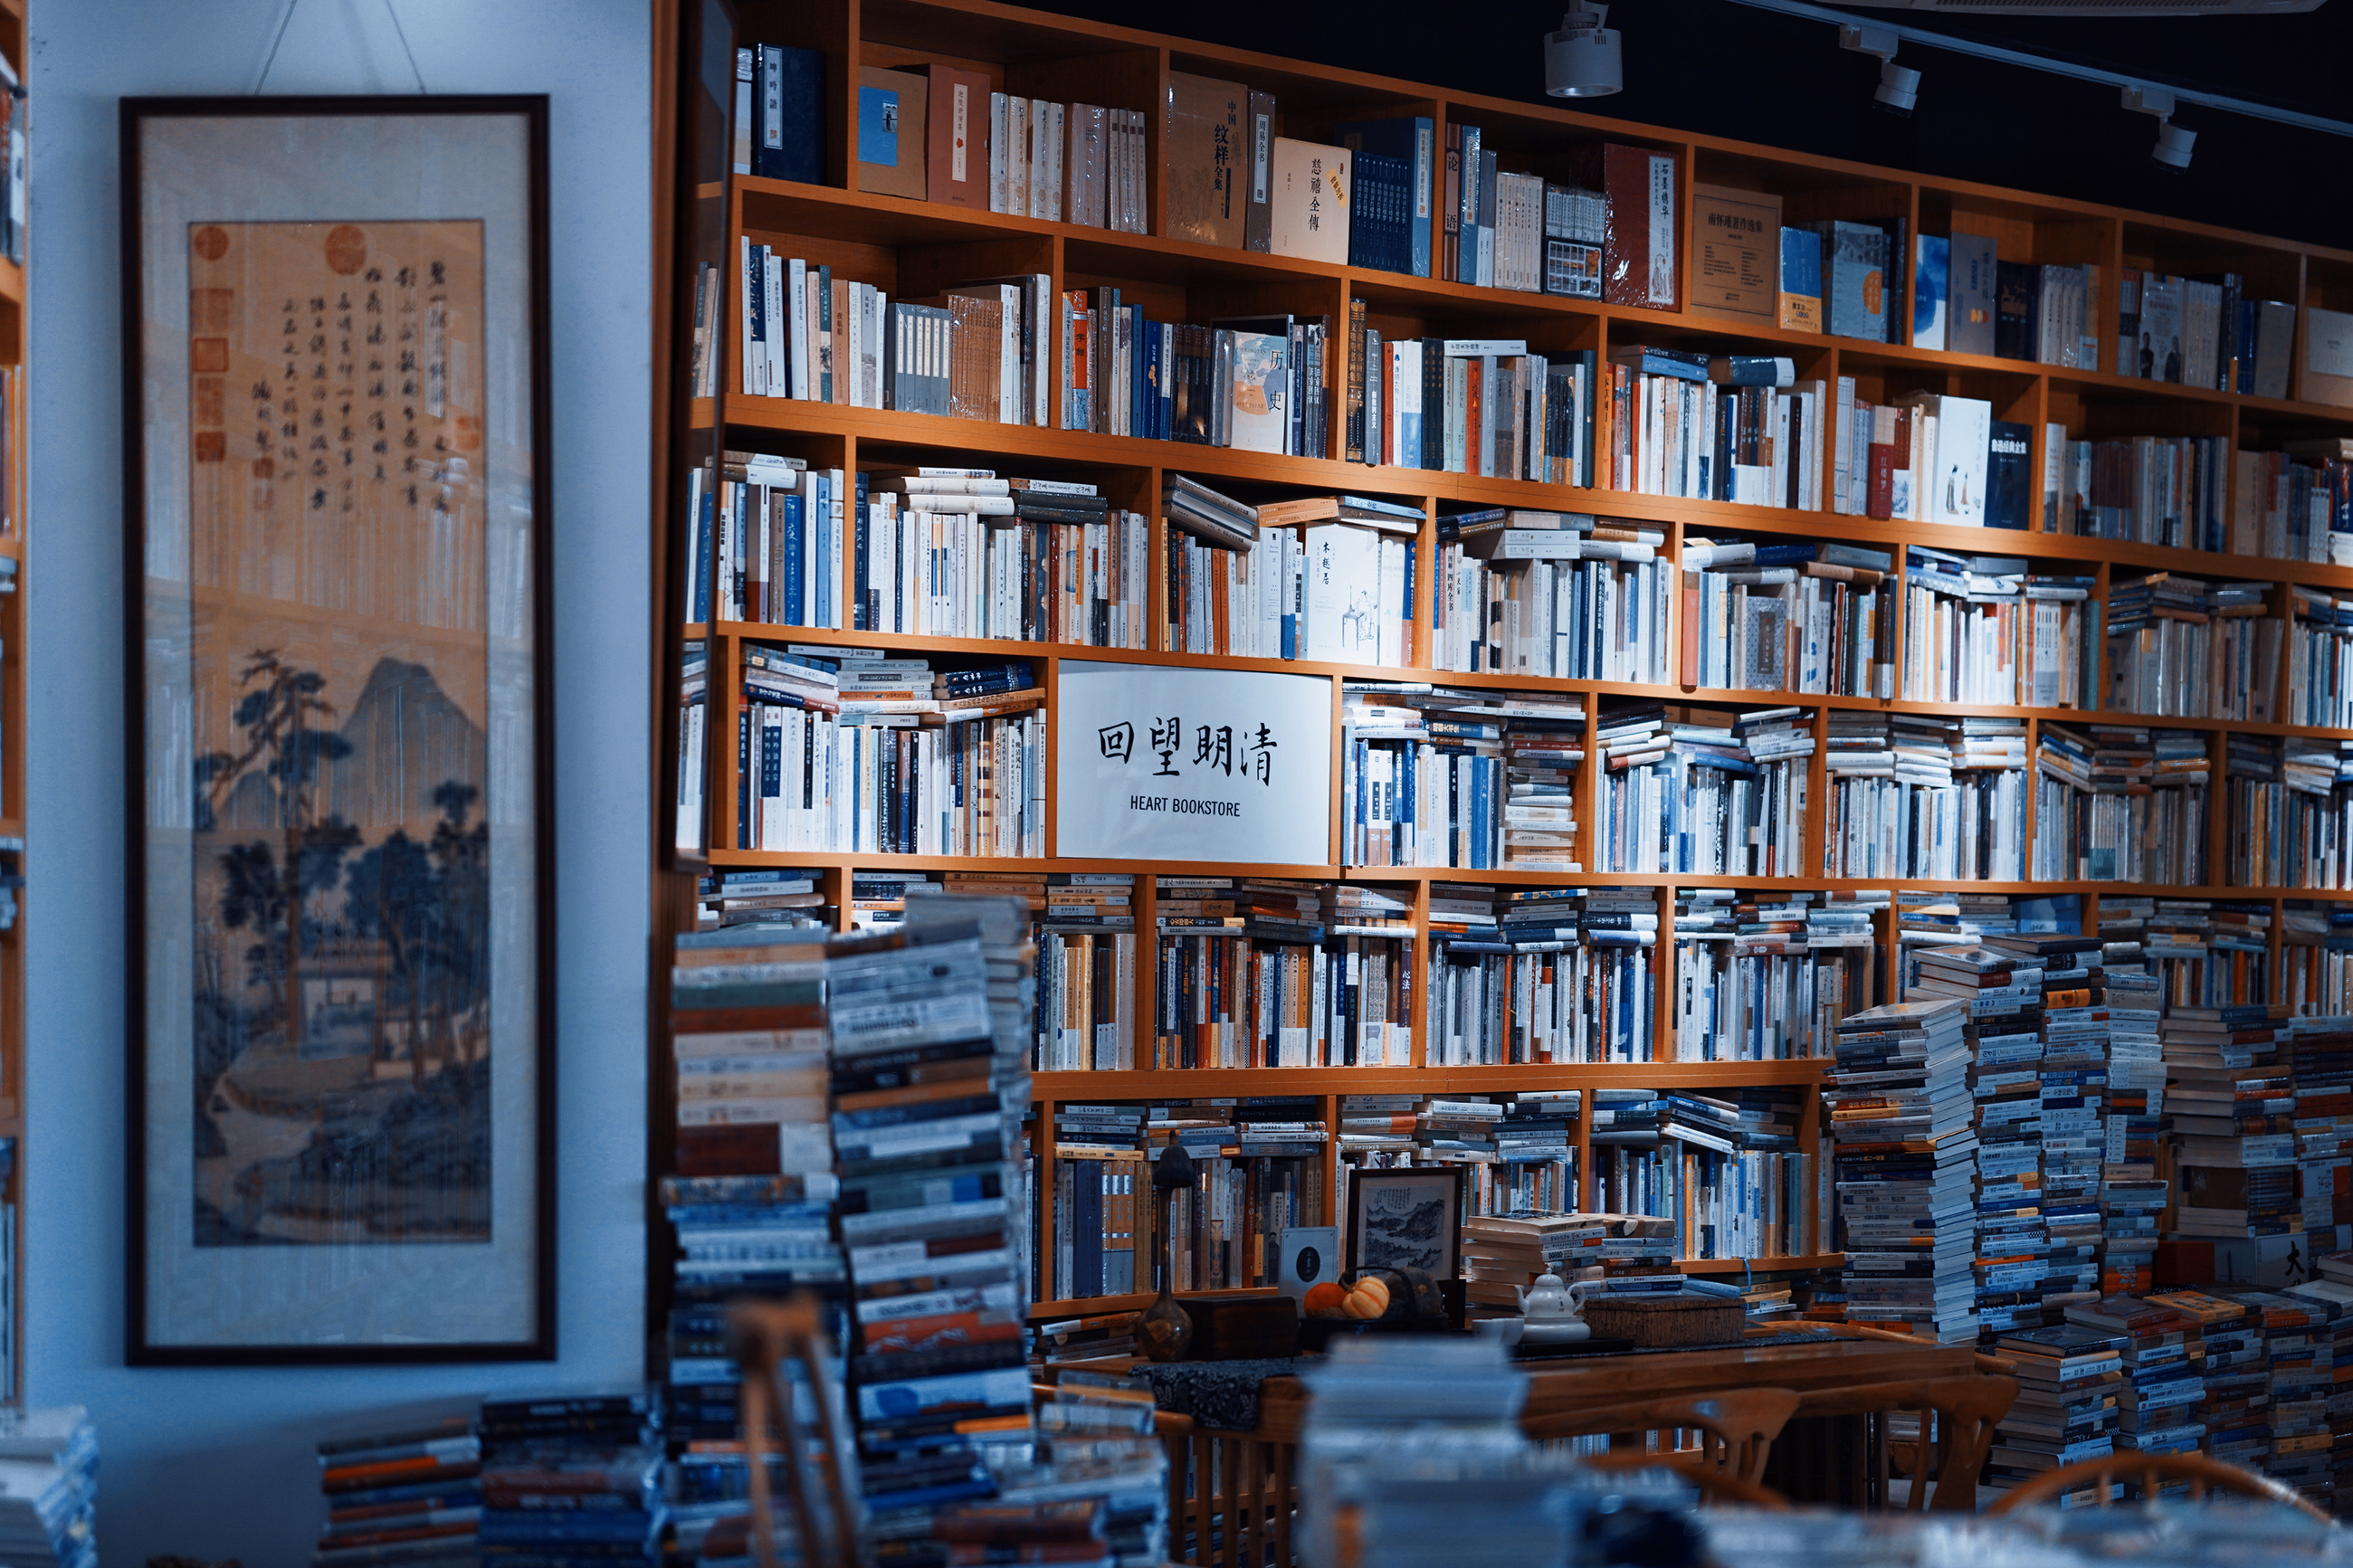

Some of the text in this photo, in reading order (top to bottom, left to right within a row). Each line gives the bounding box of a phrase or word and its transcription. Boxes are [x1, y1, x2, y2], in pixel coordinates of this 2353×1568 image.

[1227, 100, 1236, 126] 中国
[1213, 124, 1230, 191] 纹样全集
[1257, 120, 1266, 163] 周易全书
[1308, 158, 1322, 232] 慈禧全傳
[1446, 156, 1458, 230] 论语
[1270, 350, 1283, 411] 历史
[1880, 456, 1888, 489] 红楼梦
[1991, 439, 2027, 454] 鲁迅经典全集
[1098, 717, 1278, 787] 回望明清
[1130, 795, 1241, 817] HEART BOOKSTORE
